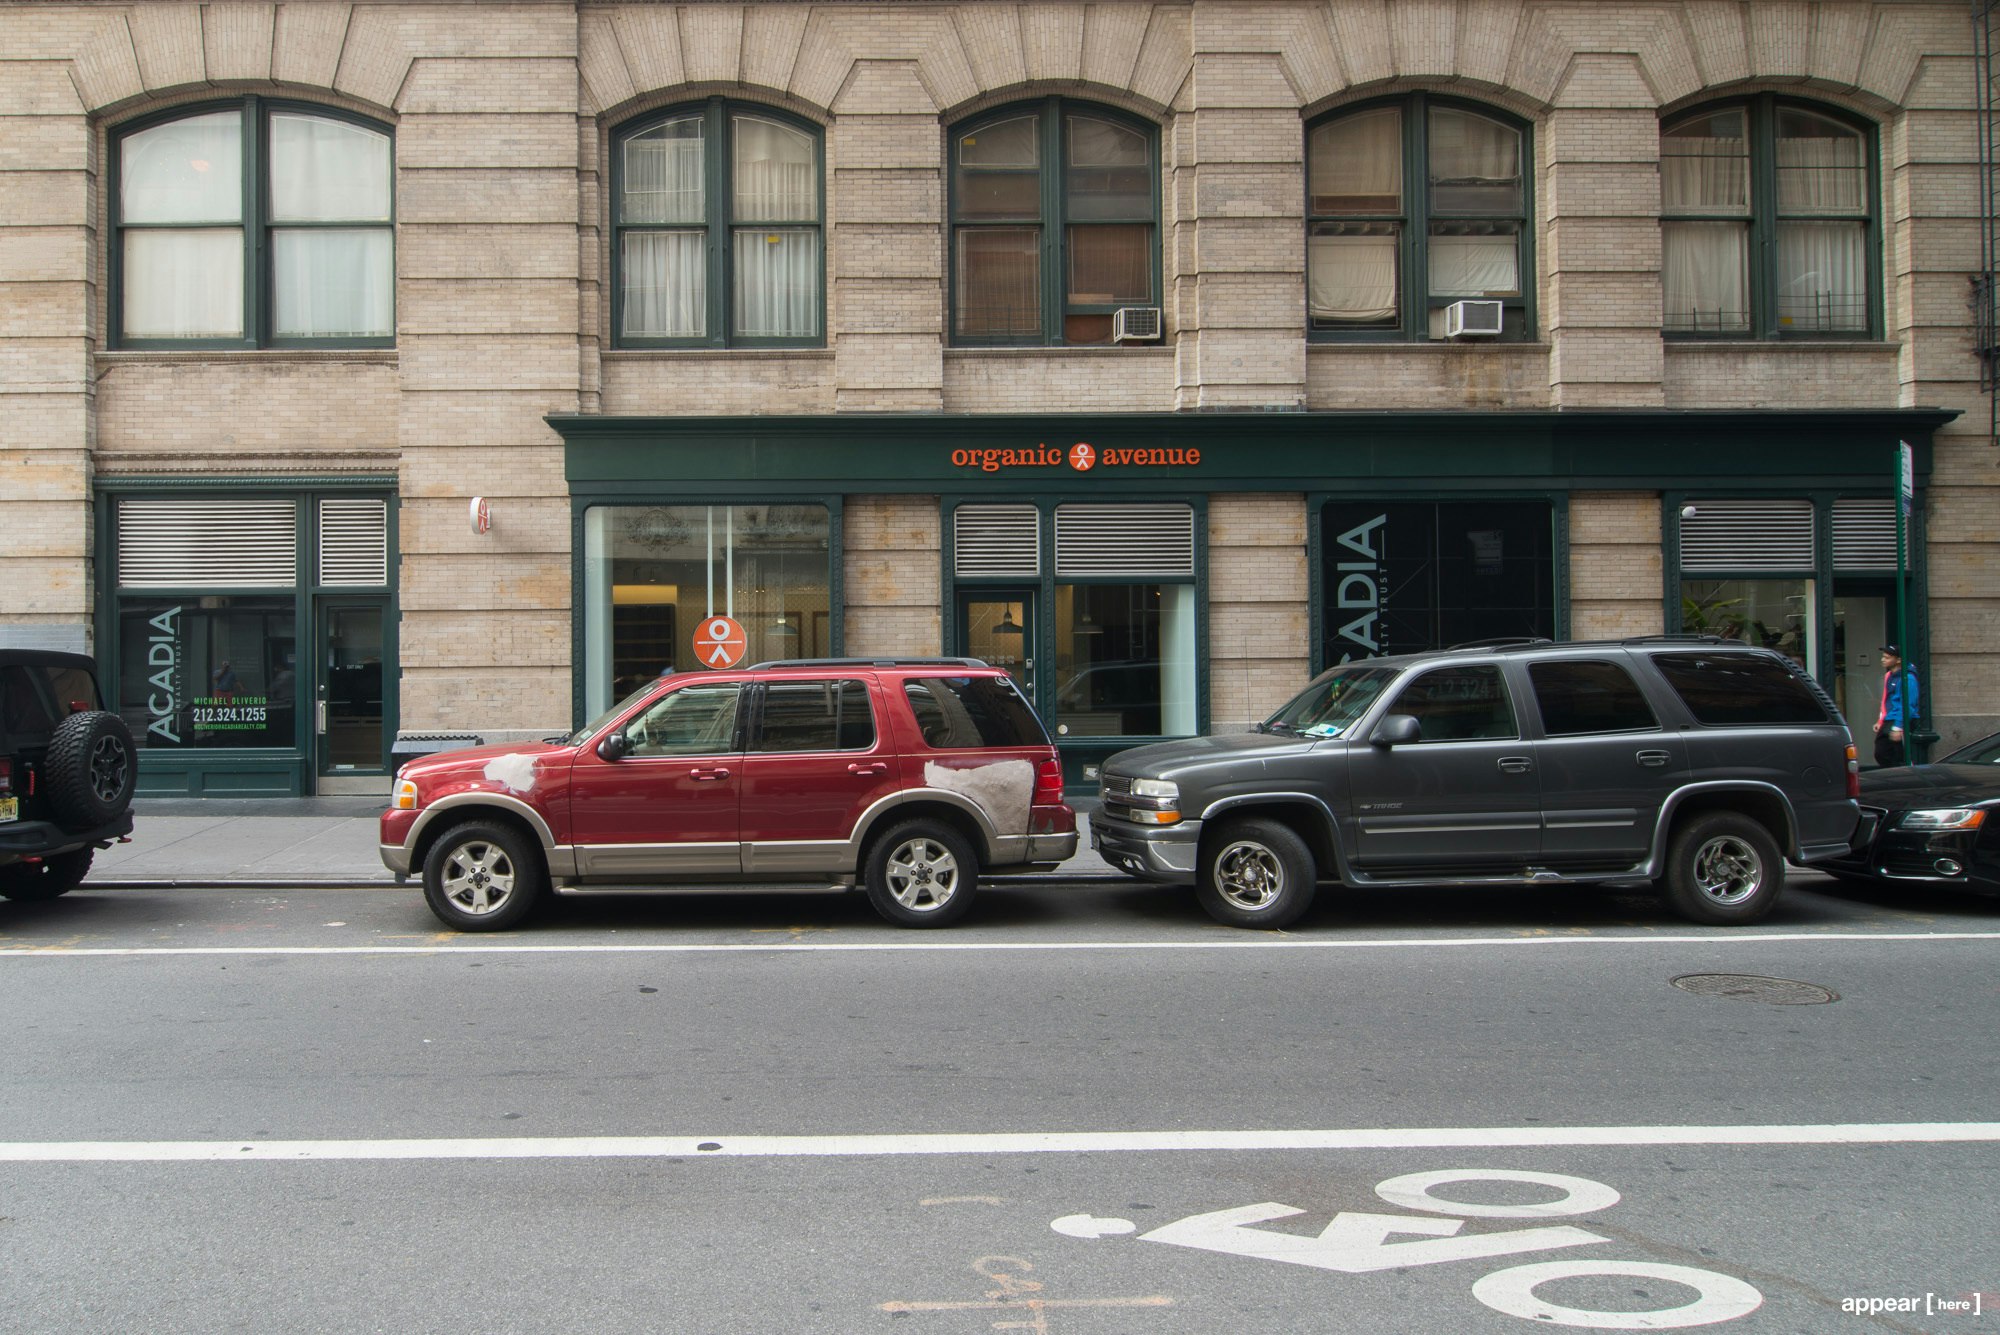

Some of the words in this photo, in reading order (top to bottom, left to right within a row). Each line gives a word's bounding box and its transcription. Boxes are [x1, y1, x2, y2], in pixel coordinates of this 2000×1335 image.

[951, 443, 1062, 472] organic
[1102, 448, 1201, 466] avenue
[1379, 567, 1389, 614] TRUST
[148, 605, 182, 743] ACADIA
[193, 707, 267, 722] 212.324.1255
[194, 697, 228, 705] MICHAEL
[231, 697, 267, 705] OLIVERIO
